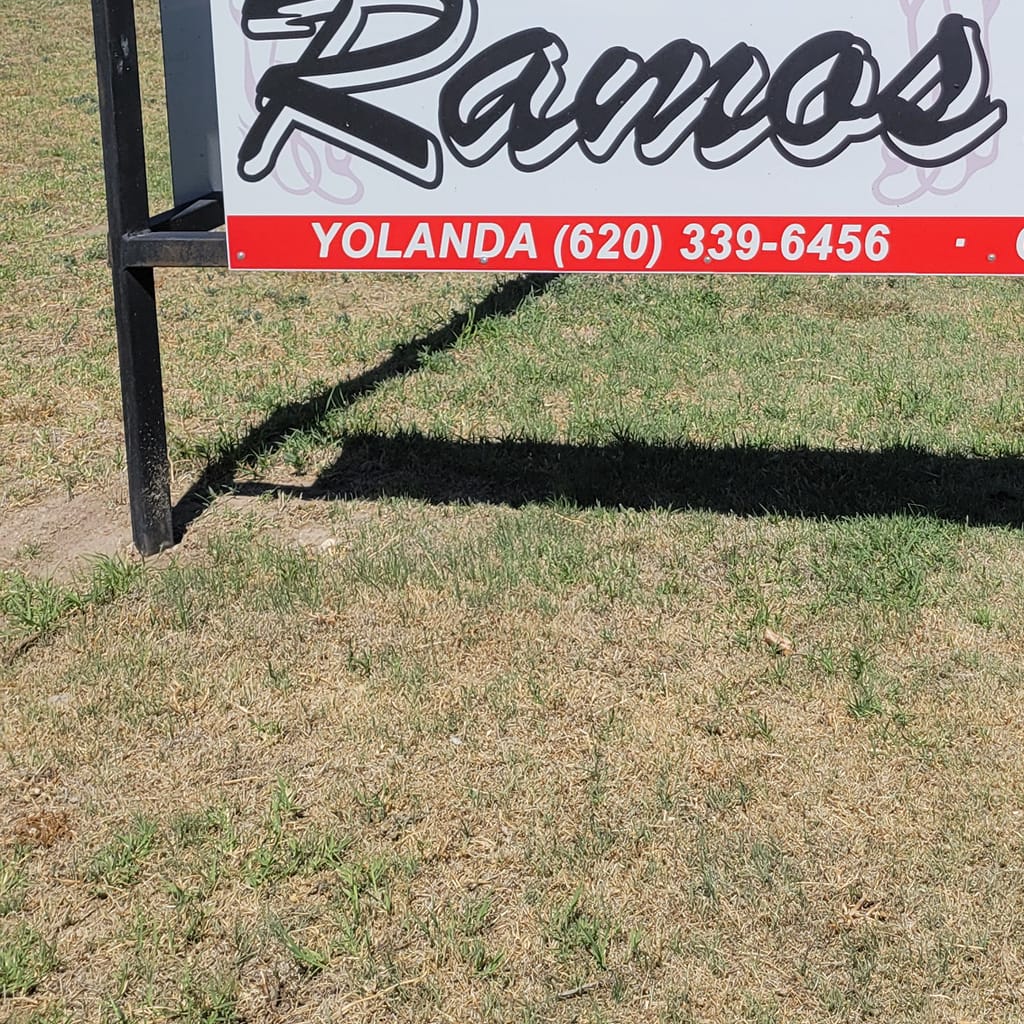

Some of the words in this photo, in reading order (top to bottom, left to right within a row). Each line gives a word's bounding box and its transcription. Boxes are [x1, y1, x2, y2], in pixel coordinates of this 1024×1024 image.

[311, 222, 537, 261] YOLANDA
[553, 222, 663, 269] (620)
[679, 222, 891, 263] 339-6456
